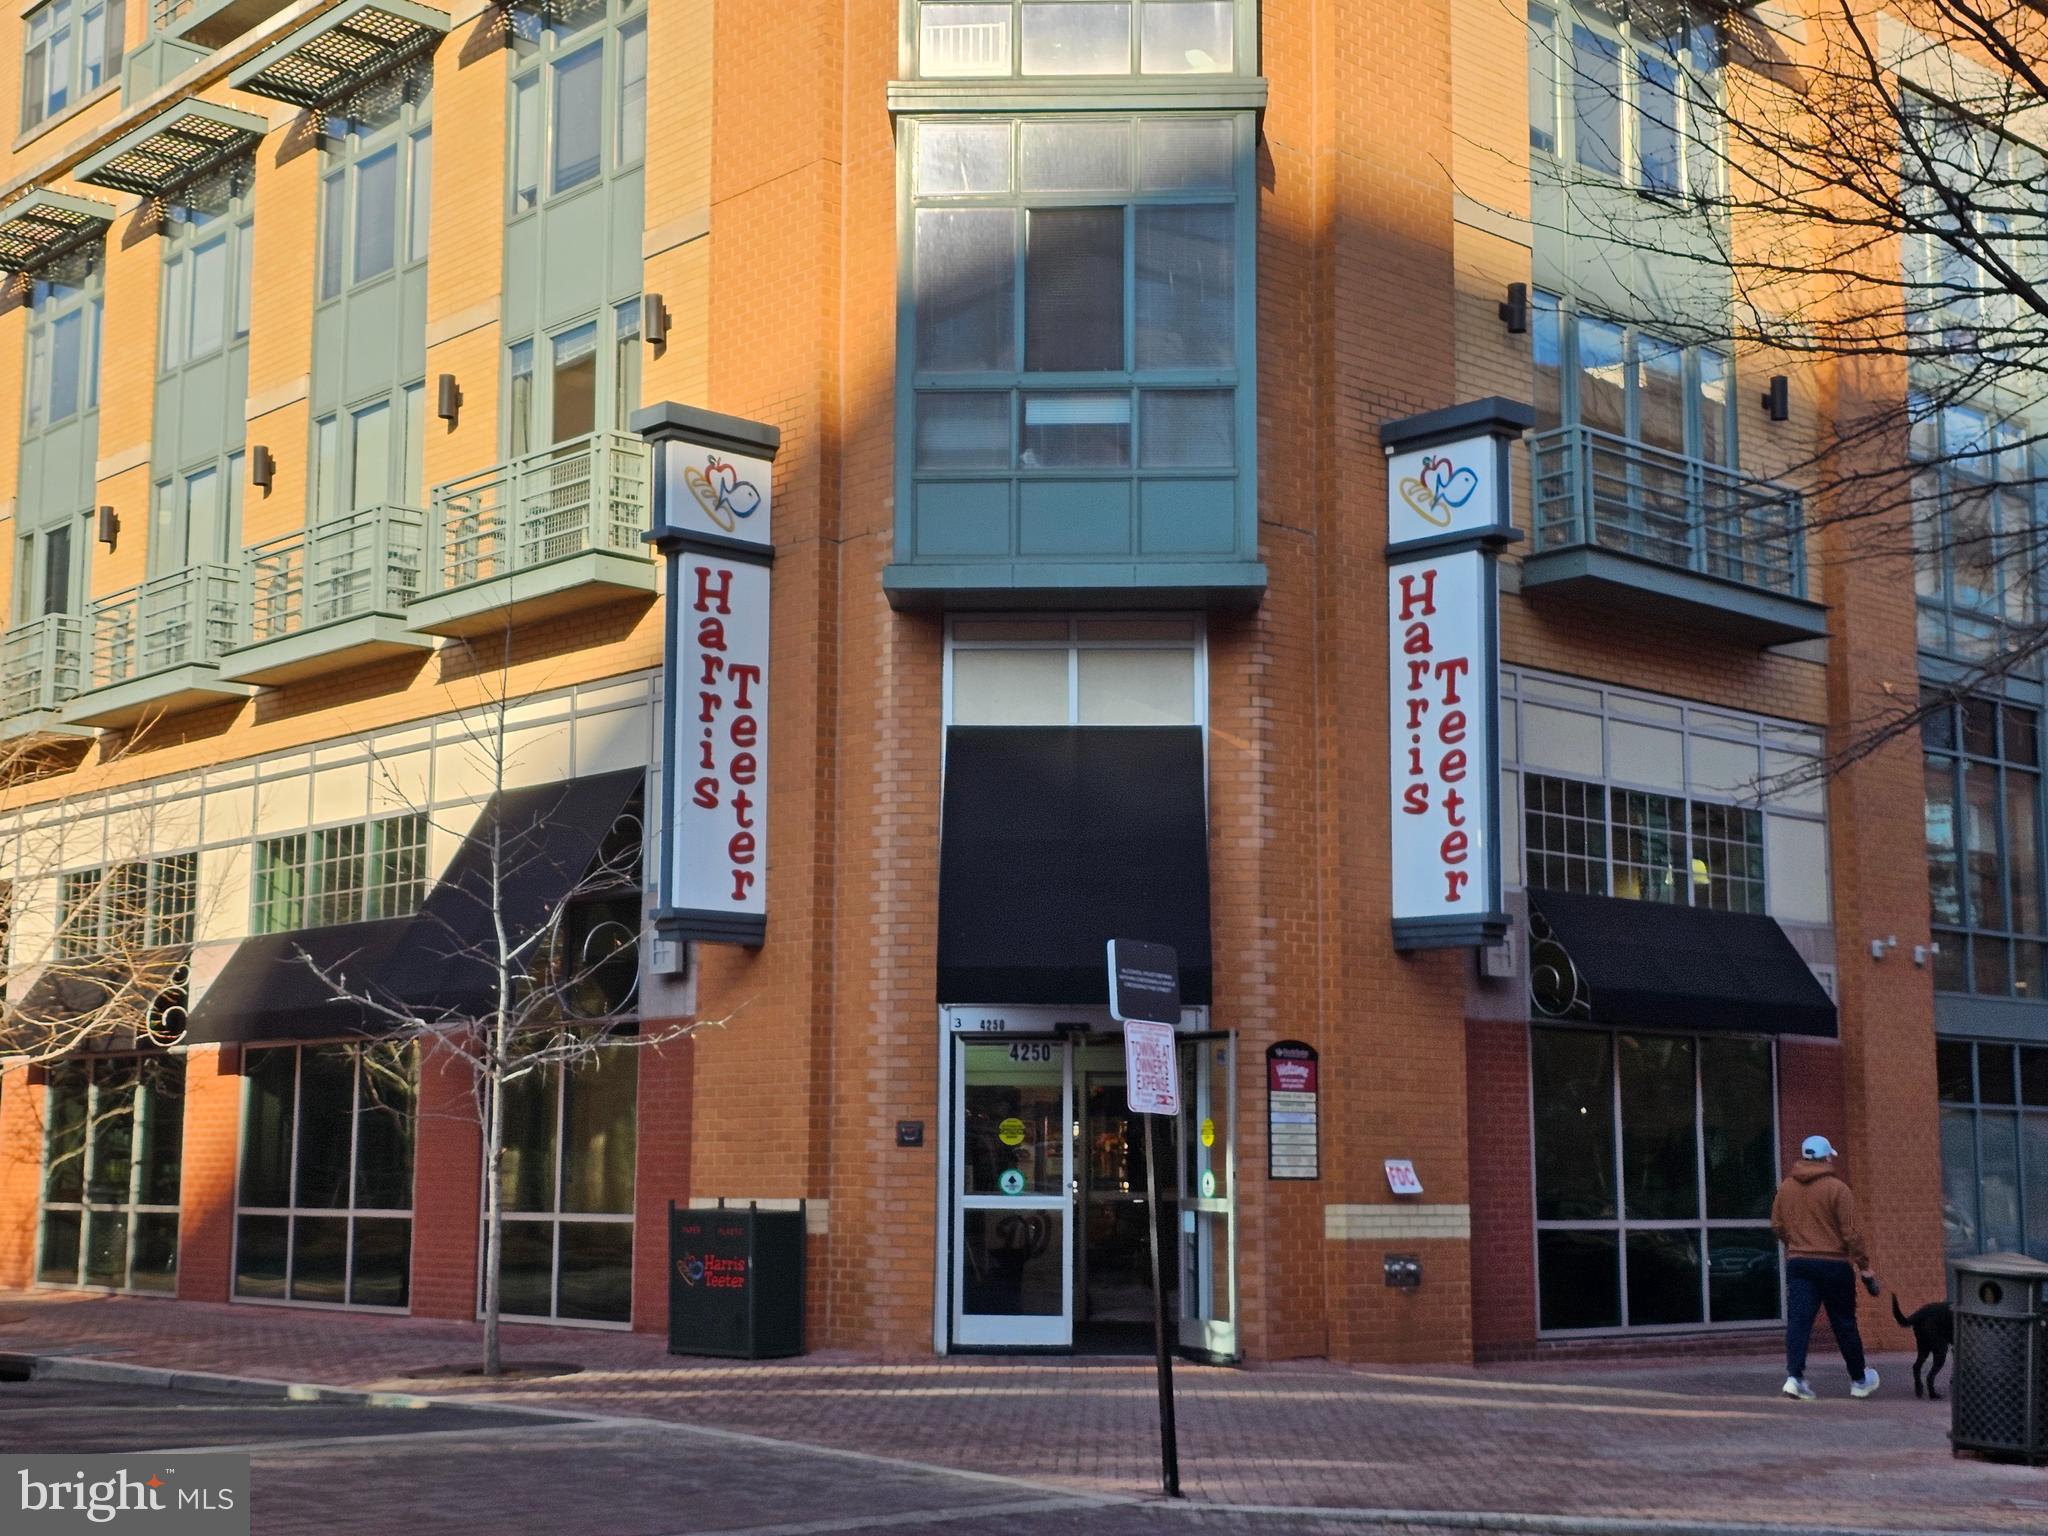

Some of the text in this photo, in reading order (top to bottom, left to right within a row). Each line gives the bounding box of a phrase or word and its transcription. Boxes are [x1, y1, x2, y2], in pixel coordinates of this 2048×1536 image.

[692, 566, 733, 810] Harris
[1398, 568, 1437, 816] Harris
[726, 663, 761, 902] Teeter
[1434, 656, 1469, 903] Teeter
[980, 1019, 1005, 1031] 4250
[1010, 1043, 1051, 1061] 4250
[1131, 1040, 1161, 1059] TOWING
[1137, 1073, 1170, 1094] EXPENSE
[705, 1254, 745, 1271] Harris
[704, 1272, 745, 1288] Teeter
